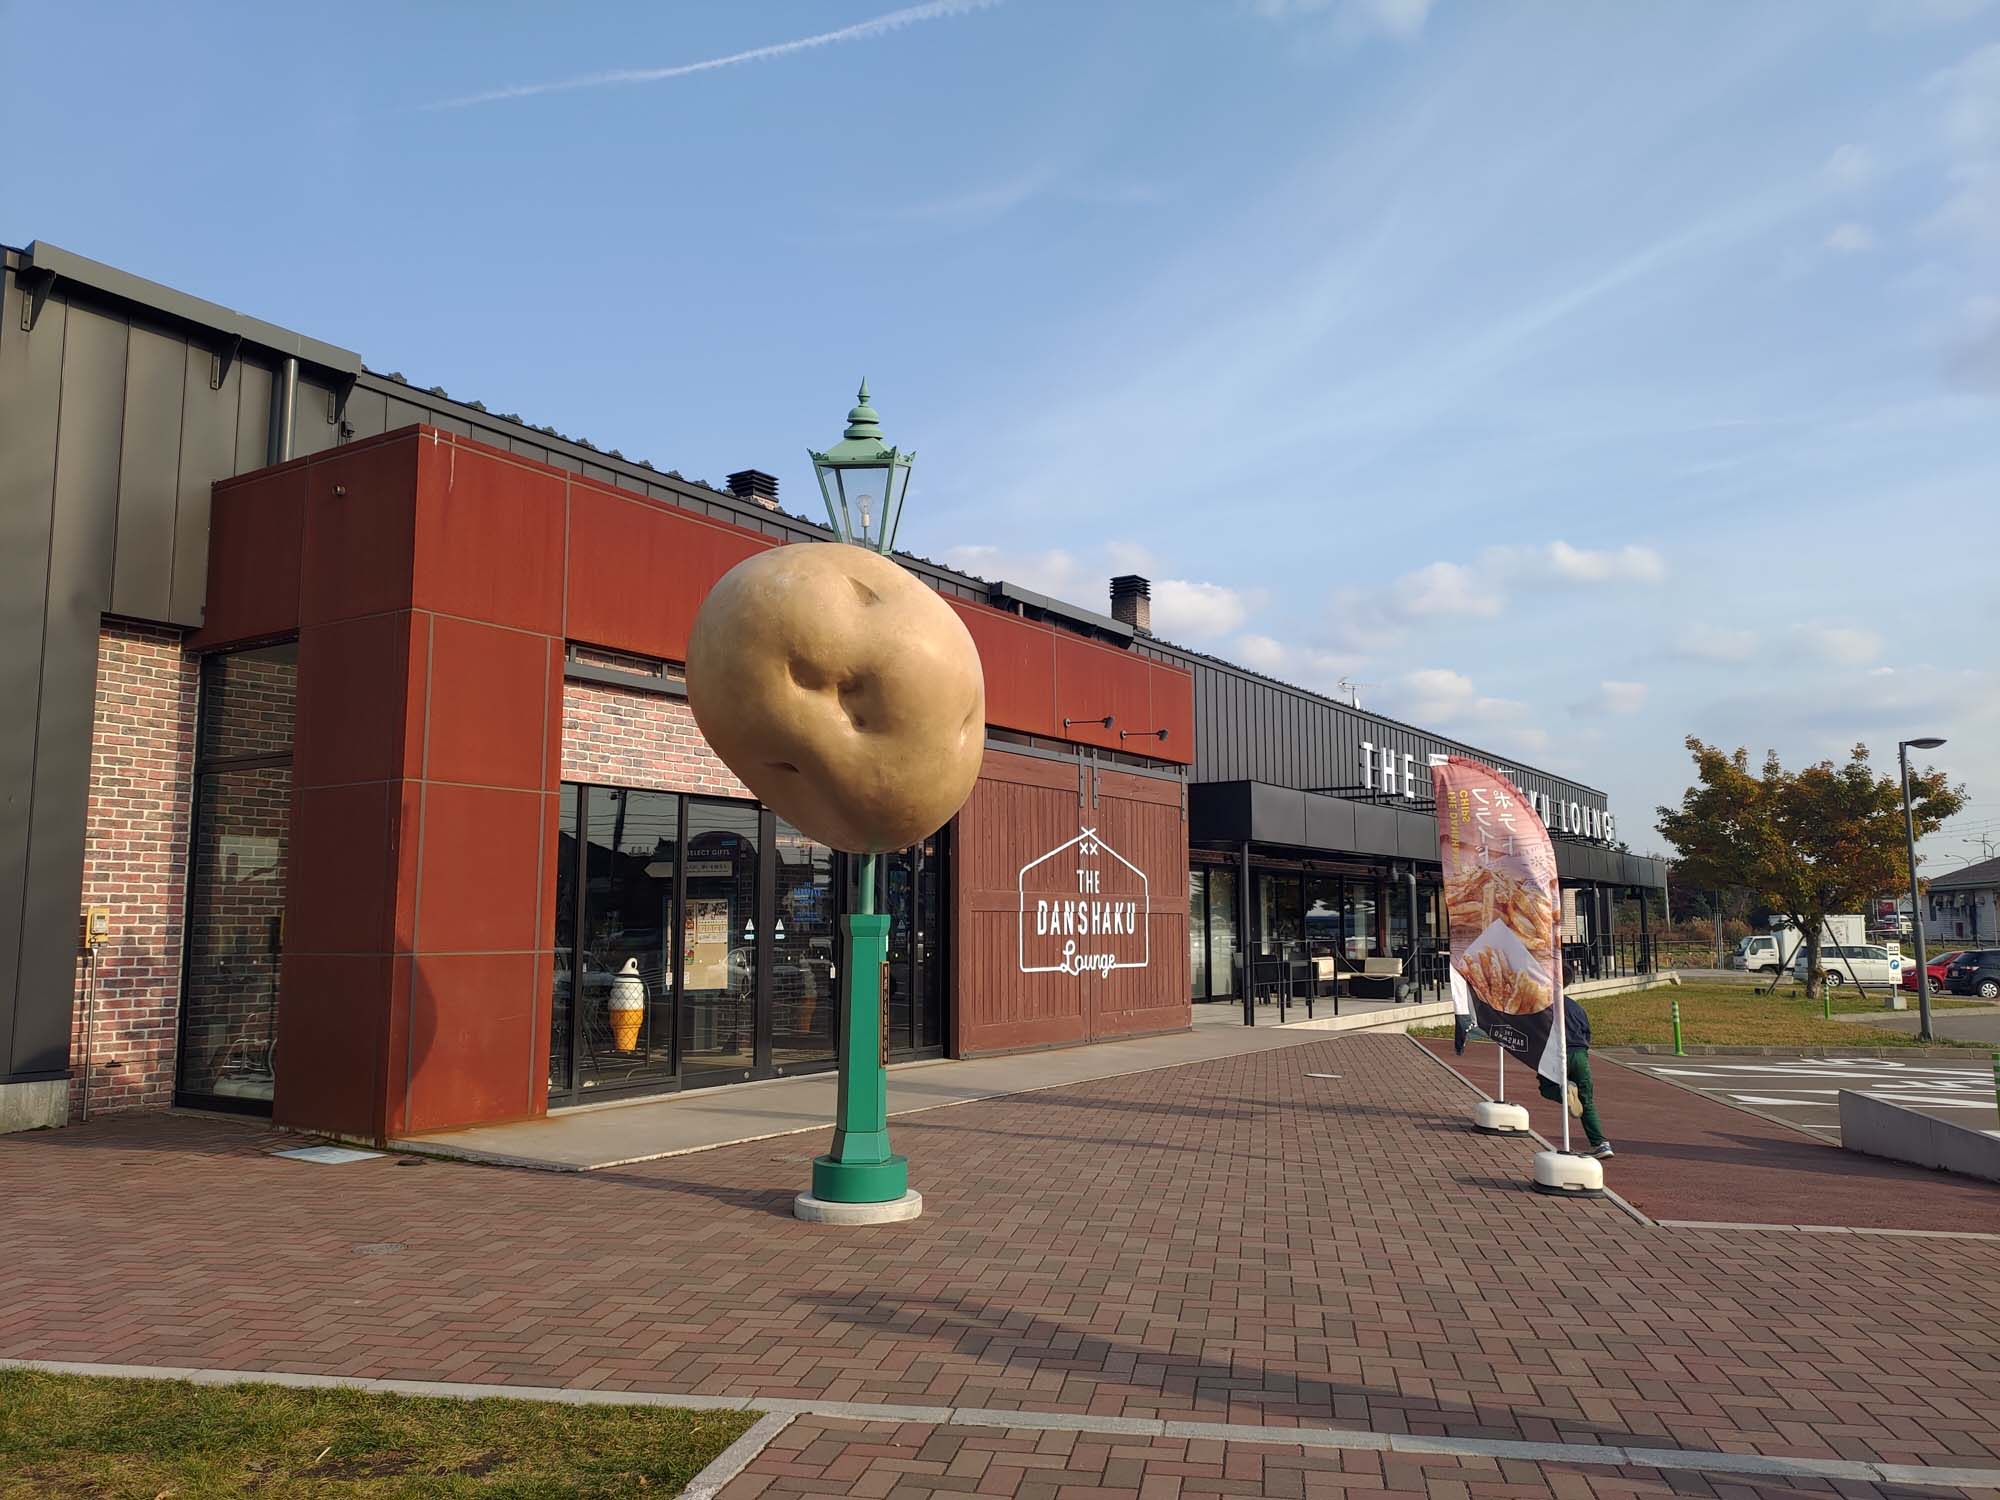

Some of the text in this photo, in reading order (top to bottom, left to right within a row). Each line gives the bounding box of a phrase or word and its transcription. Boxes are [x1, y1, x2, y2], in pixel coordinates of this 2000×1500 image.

[1361, 741, 1414, 799] THE
[1076, 870, 1100, 893] THE
[1037, 900, 1135, 935] DANSHAKU
[1060, 939, 1115, 978] Lounge
